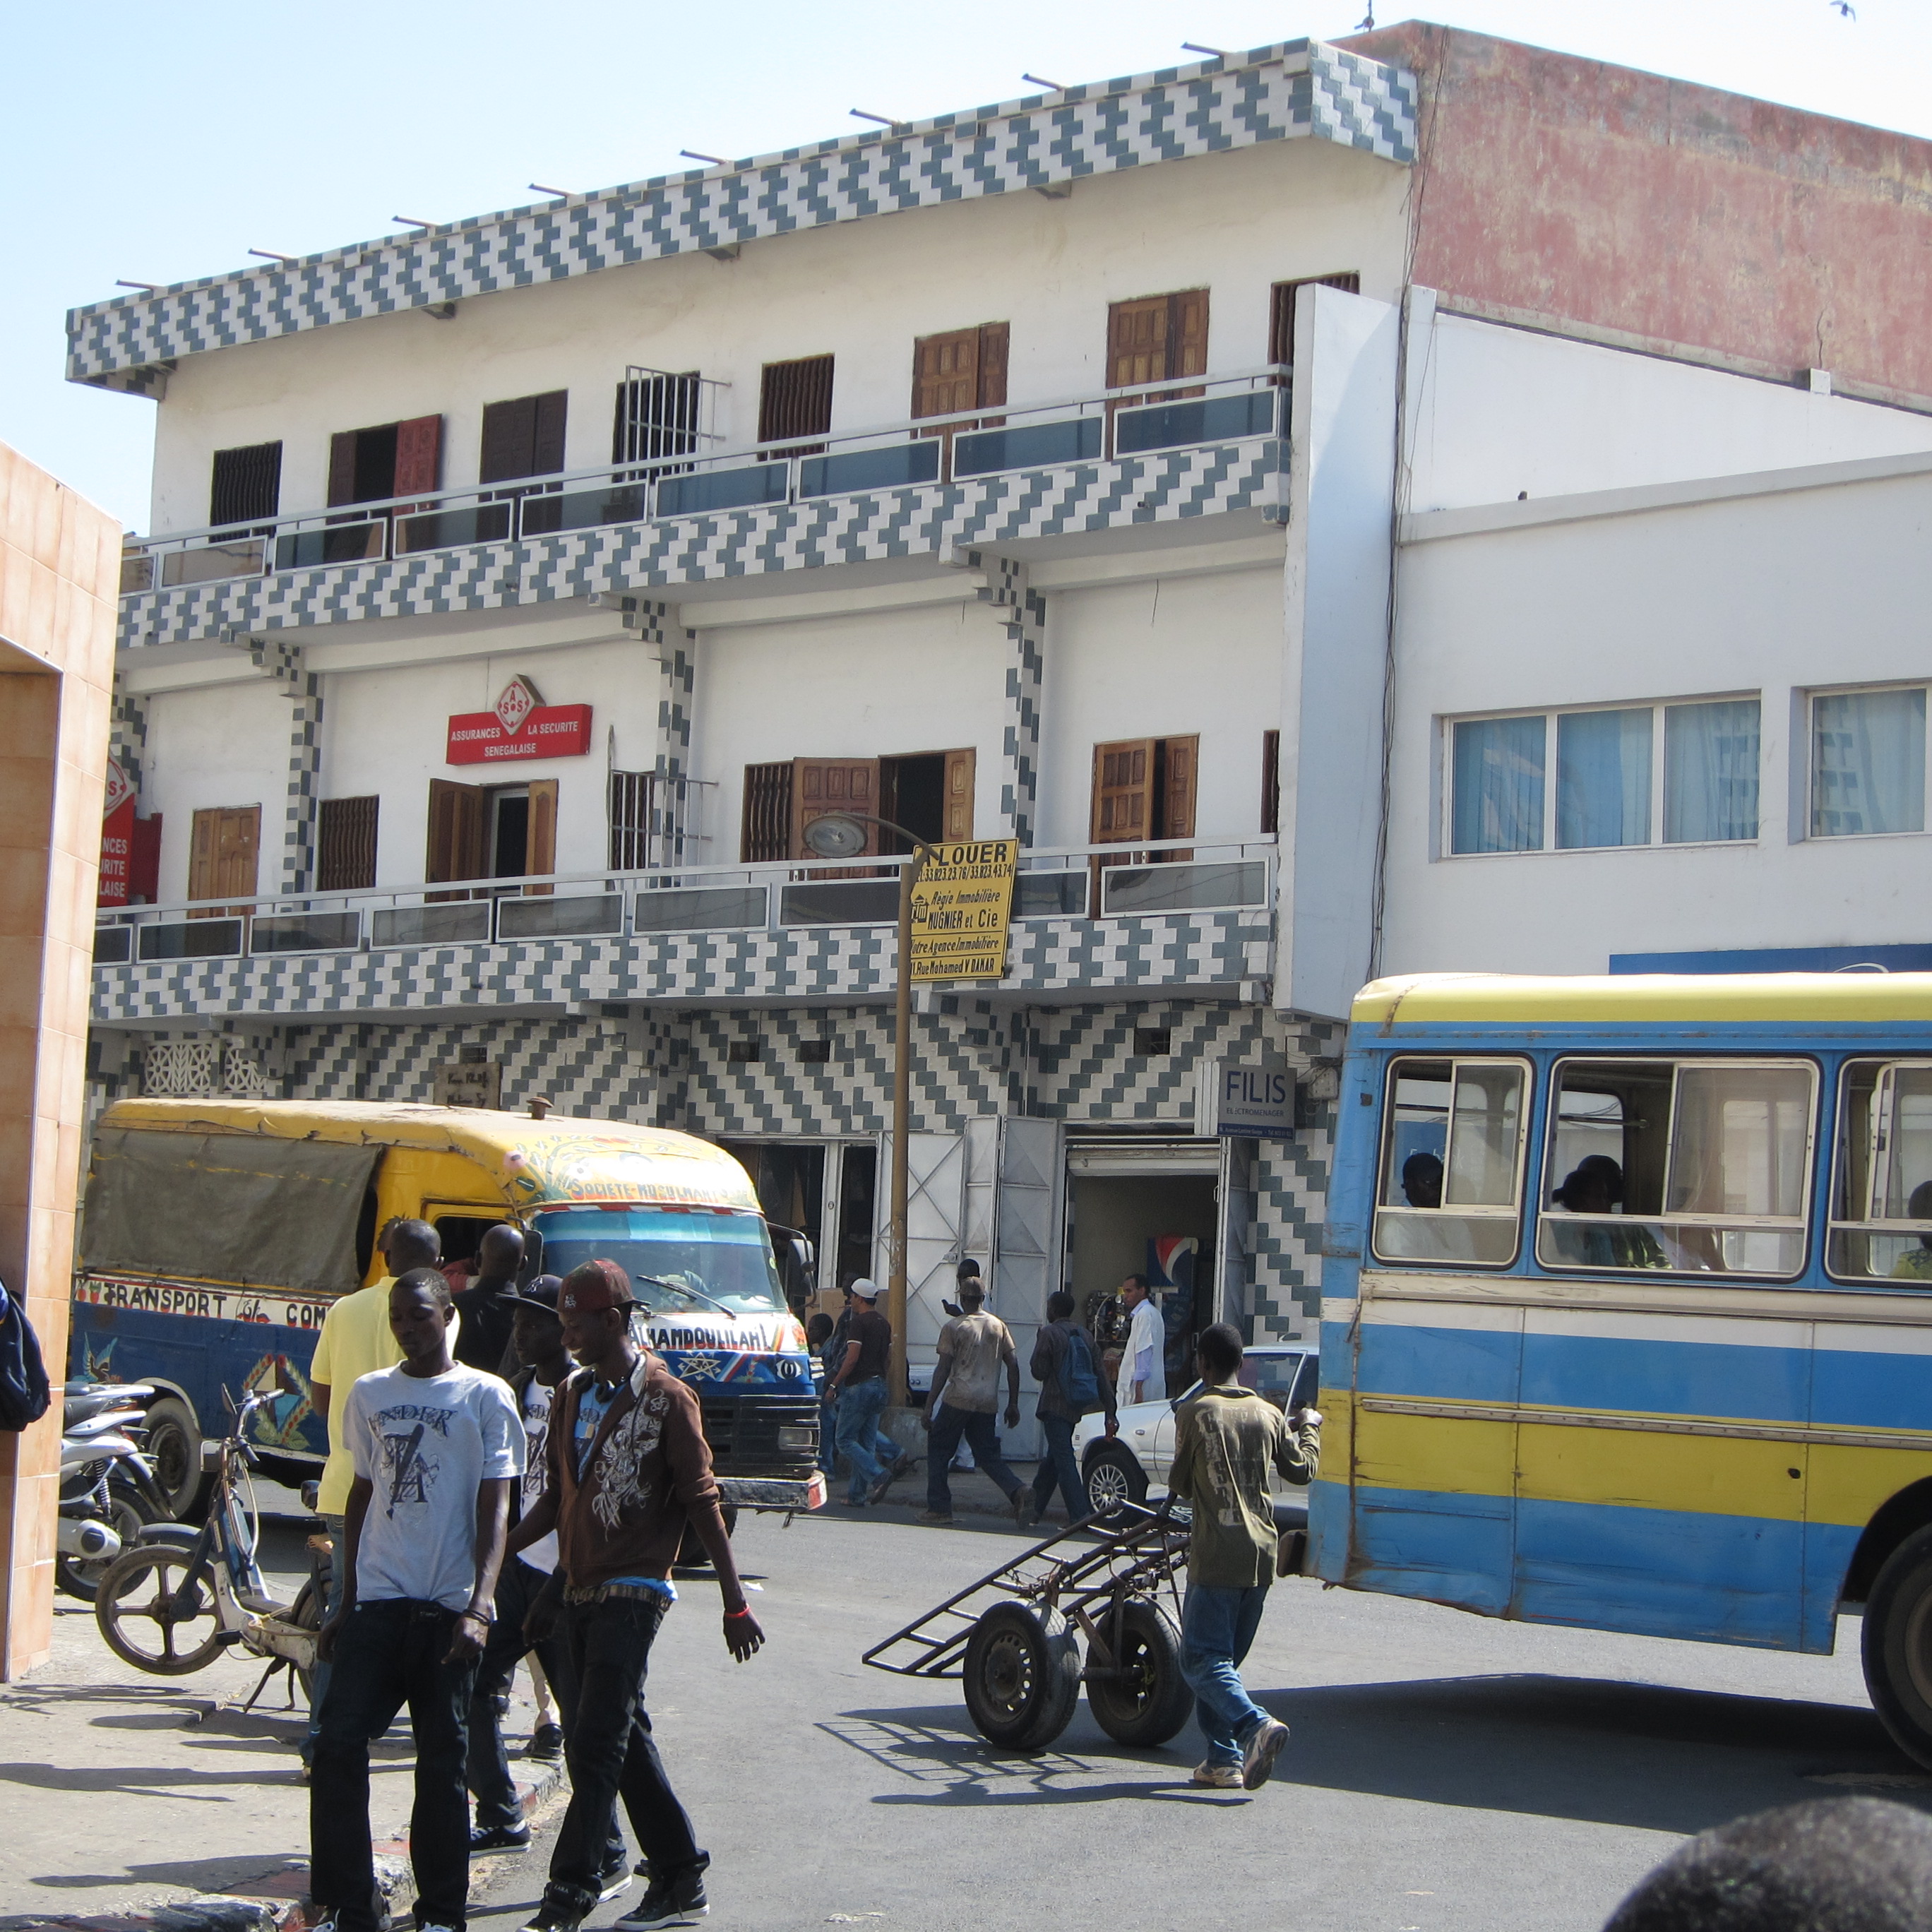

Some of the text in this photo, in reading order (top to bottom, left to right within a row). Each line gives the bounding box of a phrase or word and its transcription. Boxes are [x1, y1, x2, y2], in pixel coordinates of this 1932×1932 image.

[451, 721, 578, 741] ASSURANCES LA SECURITE
[484, 743, 537, 757] SENEGALAISE
[938, 842, 1007, 866] LOUER
[928, 908, 998, 930] MUGNIER et Cie
[928, 939, 956, 956] Agence
[929, 958, 964, 974] Mohamed
[971, 958, 995, 973] DAKAR
[1226, 1070, 1286, 1104] FILIS
[104, 1282, 227, 1319] TRANSPORT
